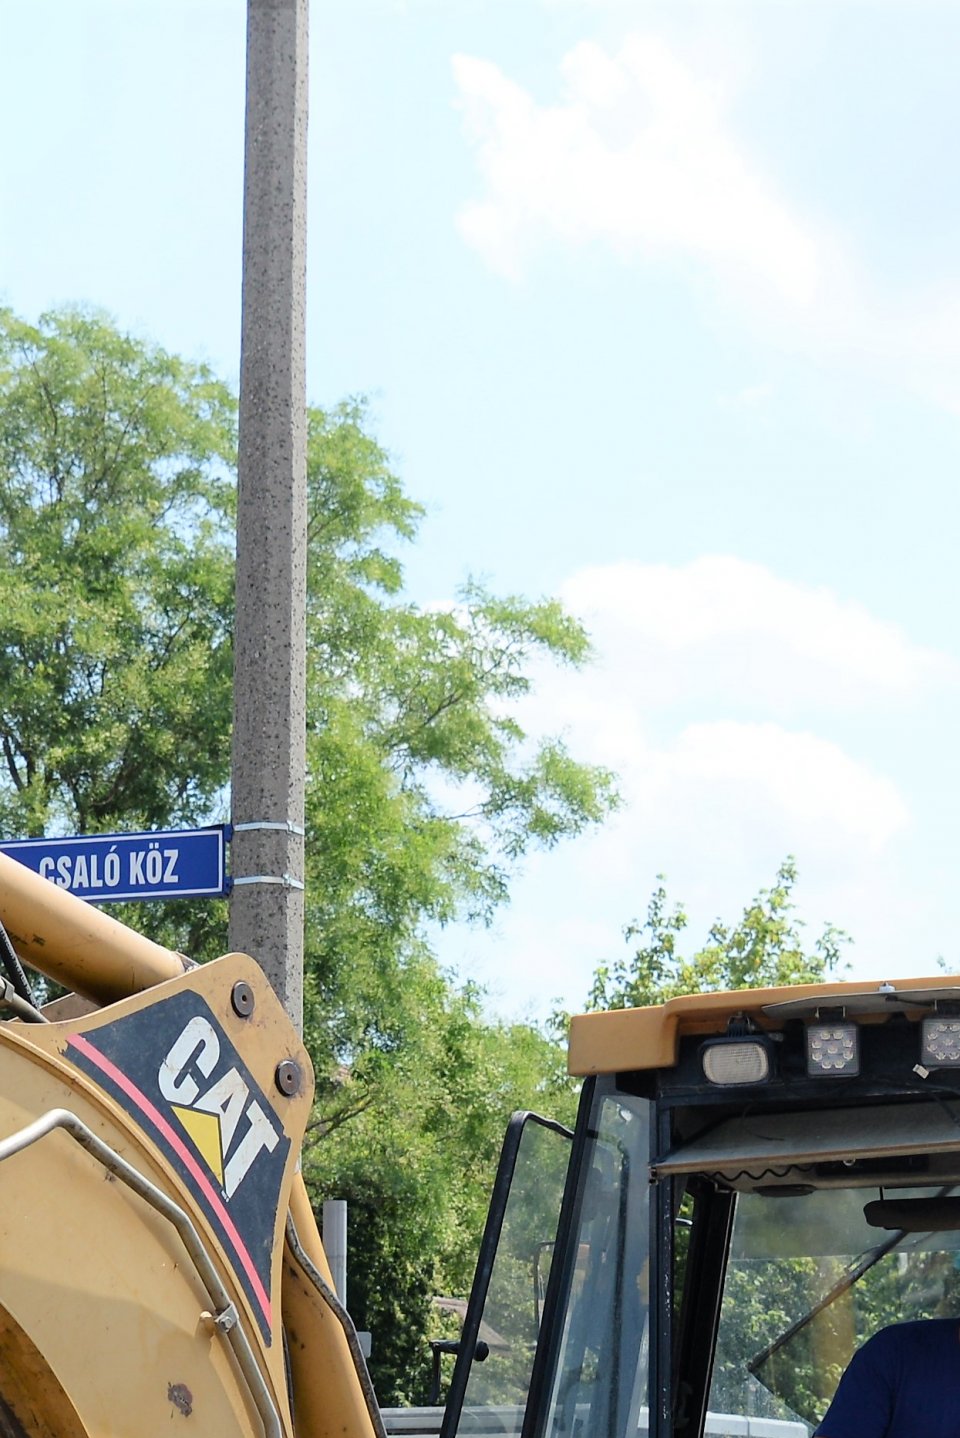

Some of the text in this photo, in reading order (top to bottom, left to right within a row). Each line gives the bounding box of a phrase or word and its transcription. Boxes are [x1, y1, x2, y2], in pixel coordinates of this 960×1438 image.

[39, 842, 179, 890] CSALÓ KÖZ
[158, 1016, 280, 1202] CAT
